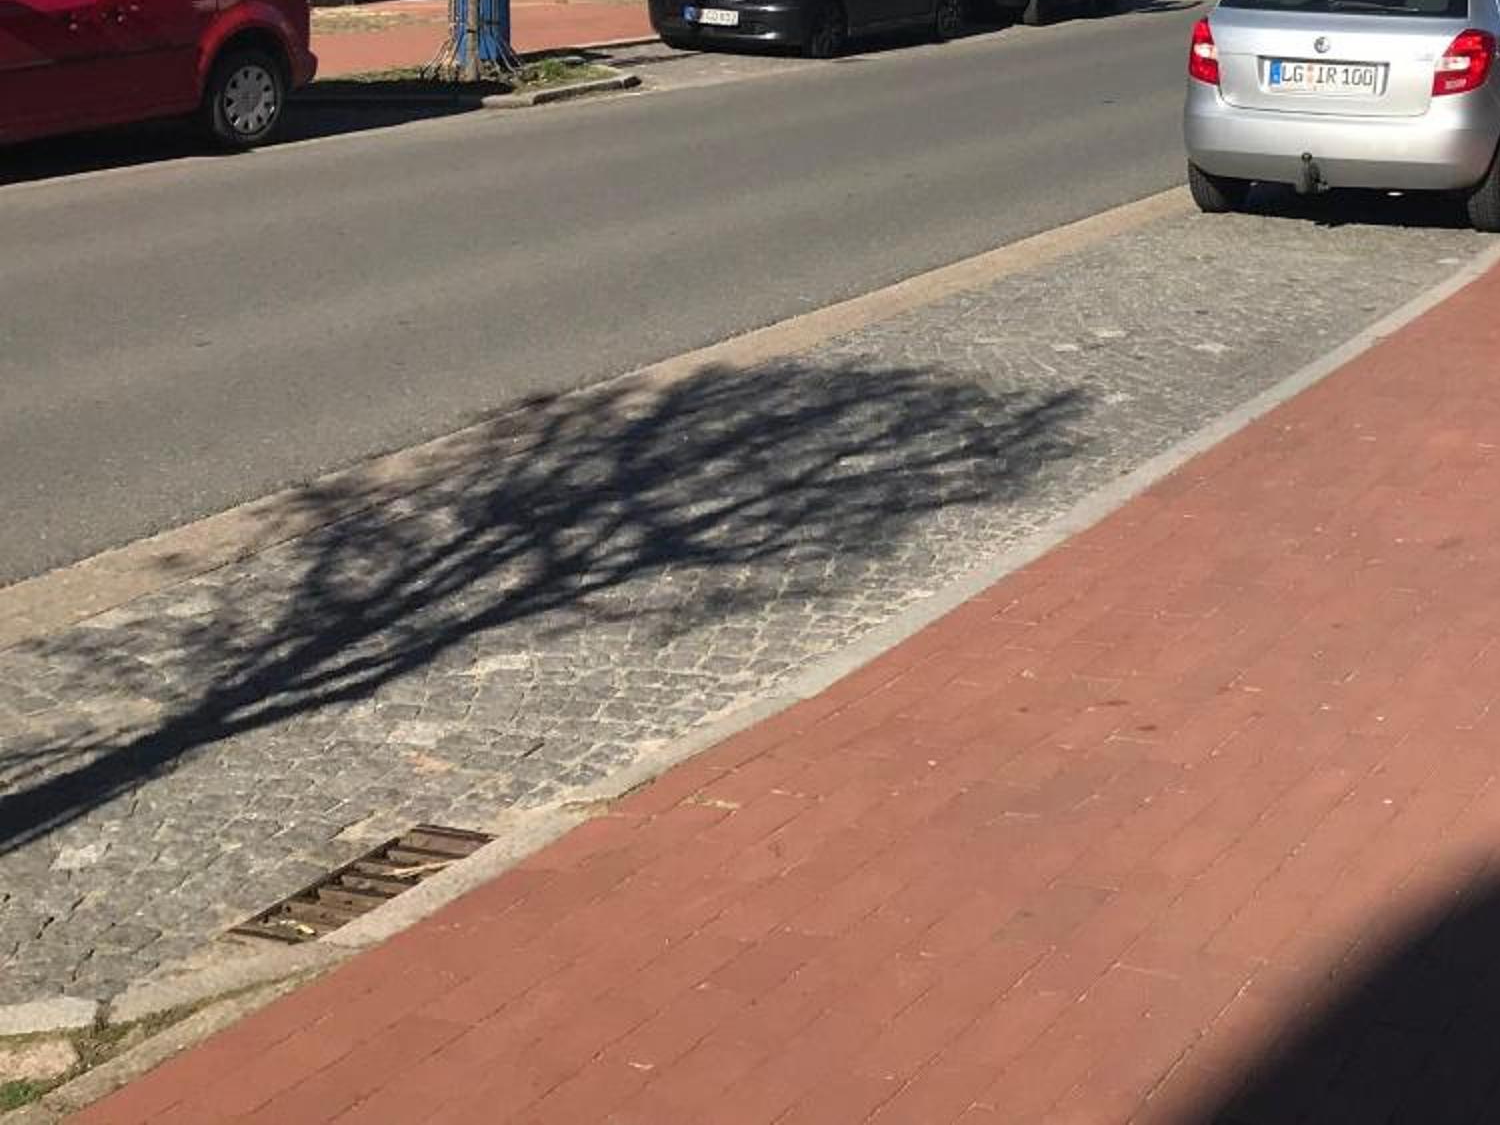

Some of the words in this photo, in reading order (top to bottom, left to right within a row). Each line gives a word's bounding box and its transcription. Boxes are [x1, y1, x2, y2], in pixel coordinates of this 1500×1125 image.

[1281, 65, 1303, 83] LG
[1315, 66, 1337, 85] IR
[1342, 68, 1373, 87] 100
